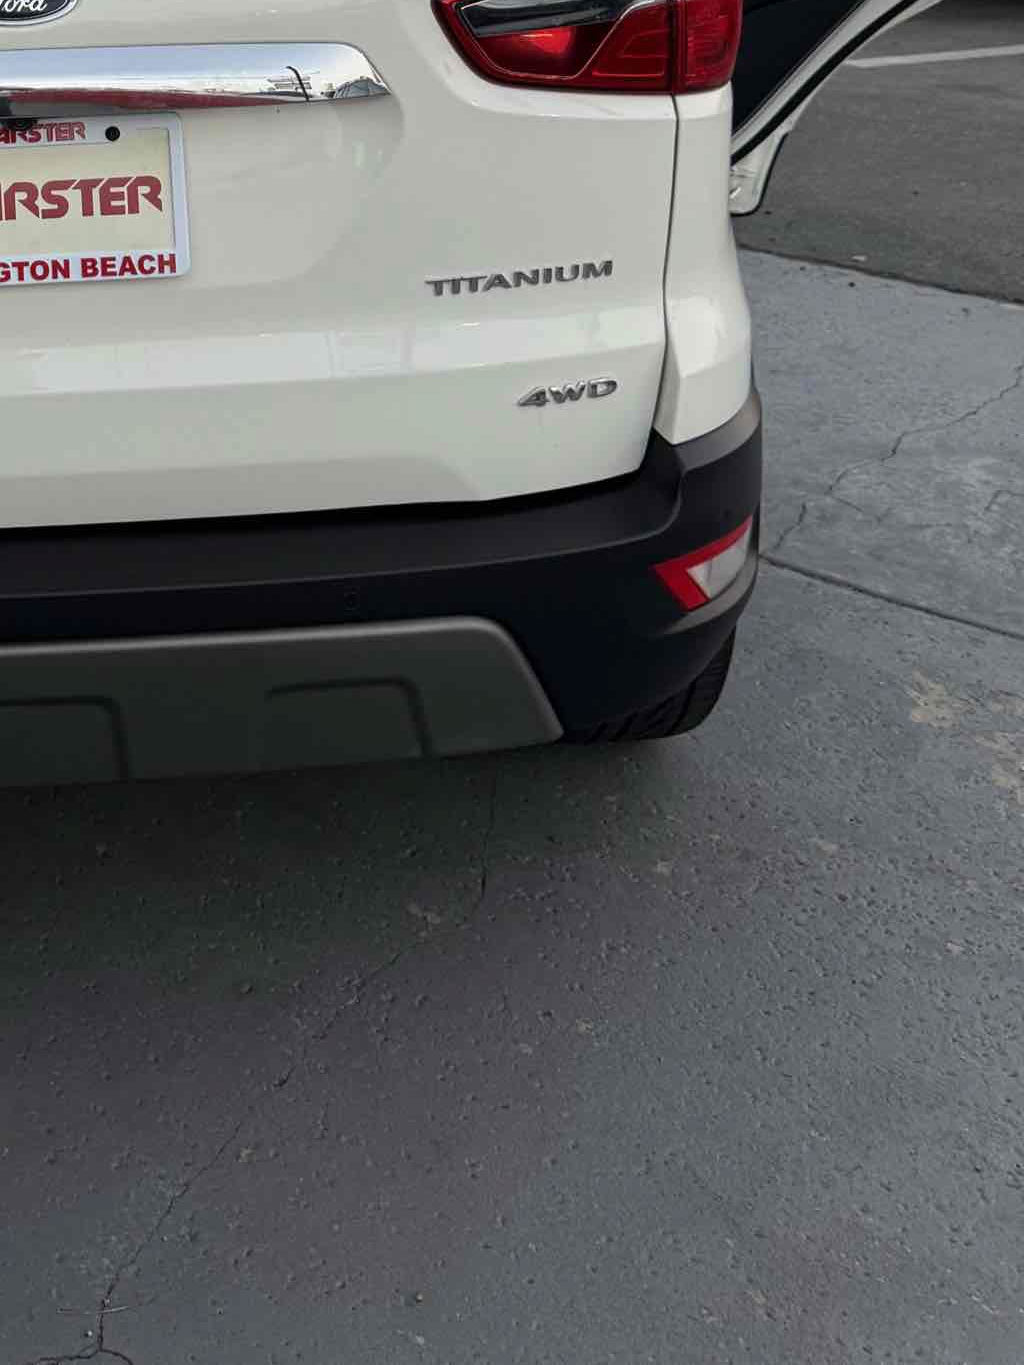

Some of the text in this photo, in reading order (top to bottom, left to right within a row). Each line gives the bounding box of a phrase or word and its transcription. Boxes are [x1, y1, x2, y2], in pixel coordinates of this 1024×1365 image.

[80, 253, 177, 279] BEACH
[424, 260, 614, 296] TITANIUM
[516, 378, 618, 408] 4WD
